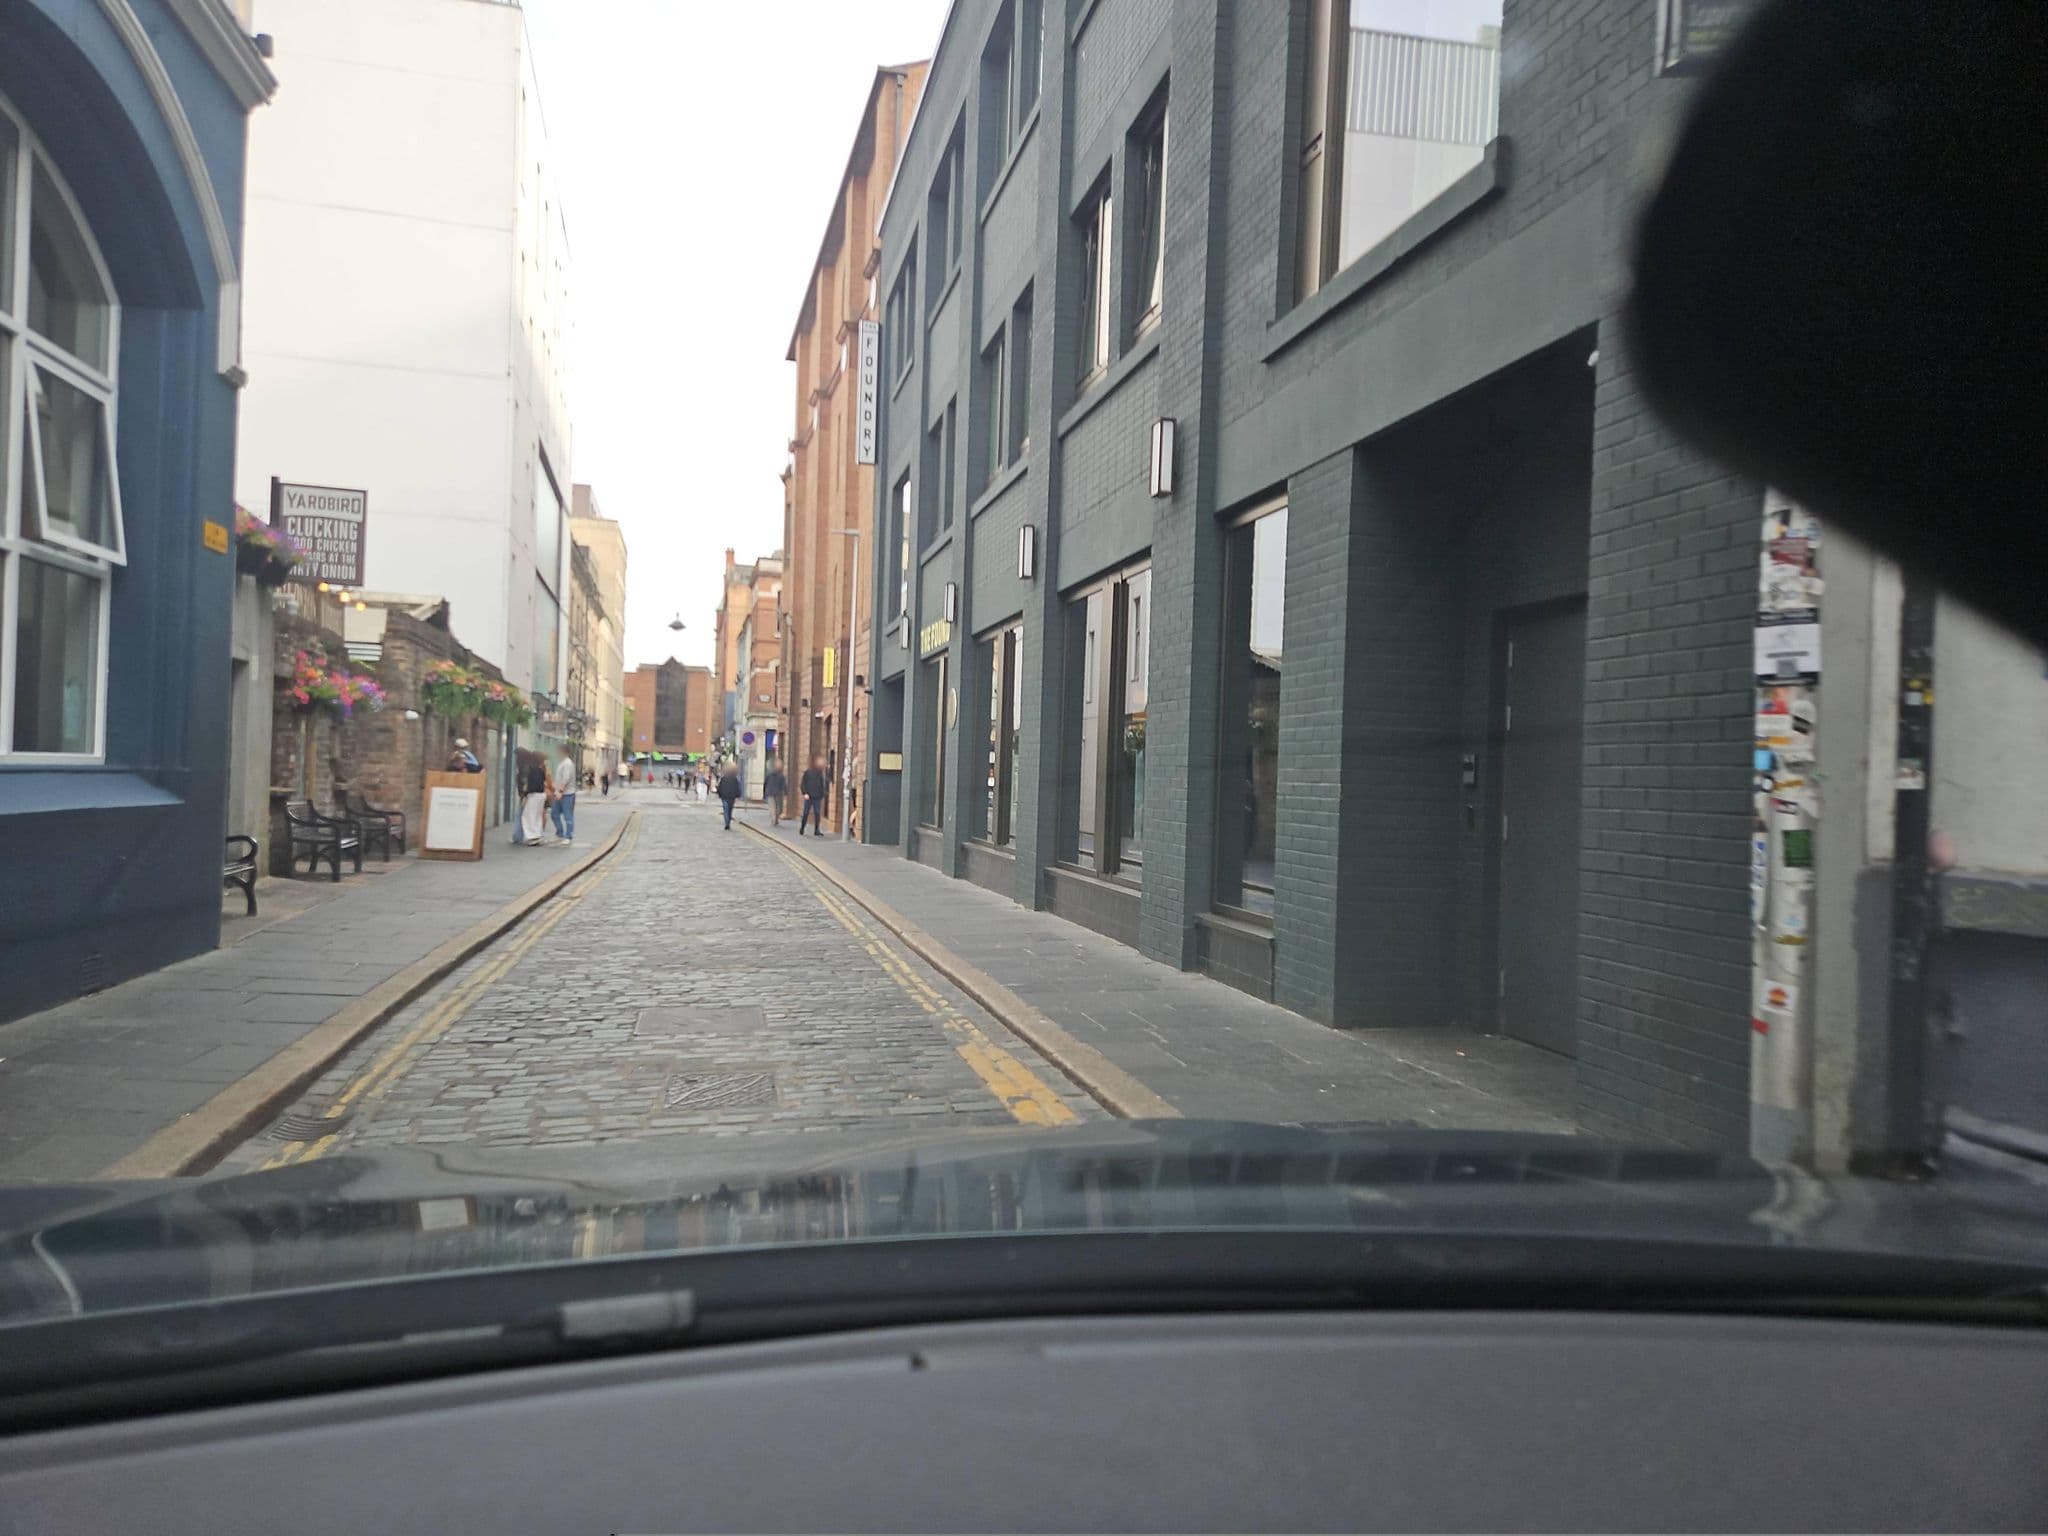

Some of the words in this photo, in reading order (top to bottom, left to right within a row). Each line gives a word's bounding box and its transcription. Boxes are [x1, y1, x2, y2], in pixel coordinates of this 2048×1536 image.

[864, 338, 874, 456] FOUNDRY
[287, 492, 361, 513] YARDBIRD
[287, 516, 358, 540] CLUCKING
[316, 538, 357, 553] CHICKEN
[342, 554, 356, 565] THE
[321, 564, 356, 580] ONION
